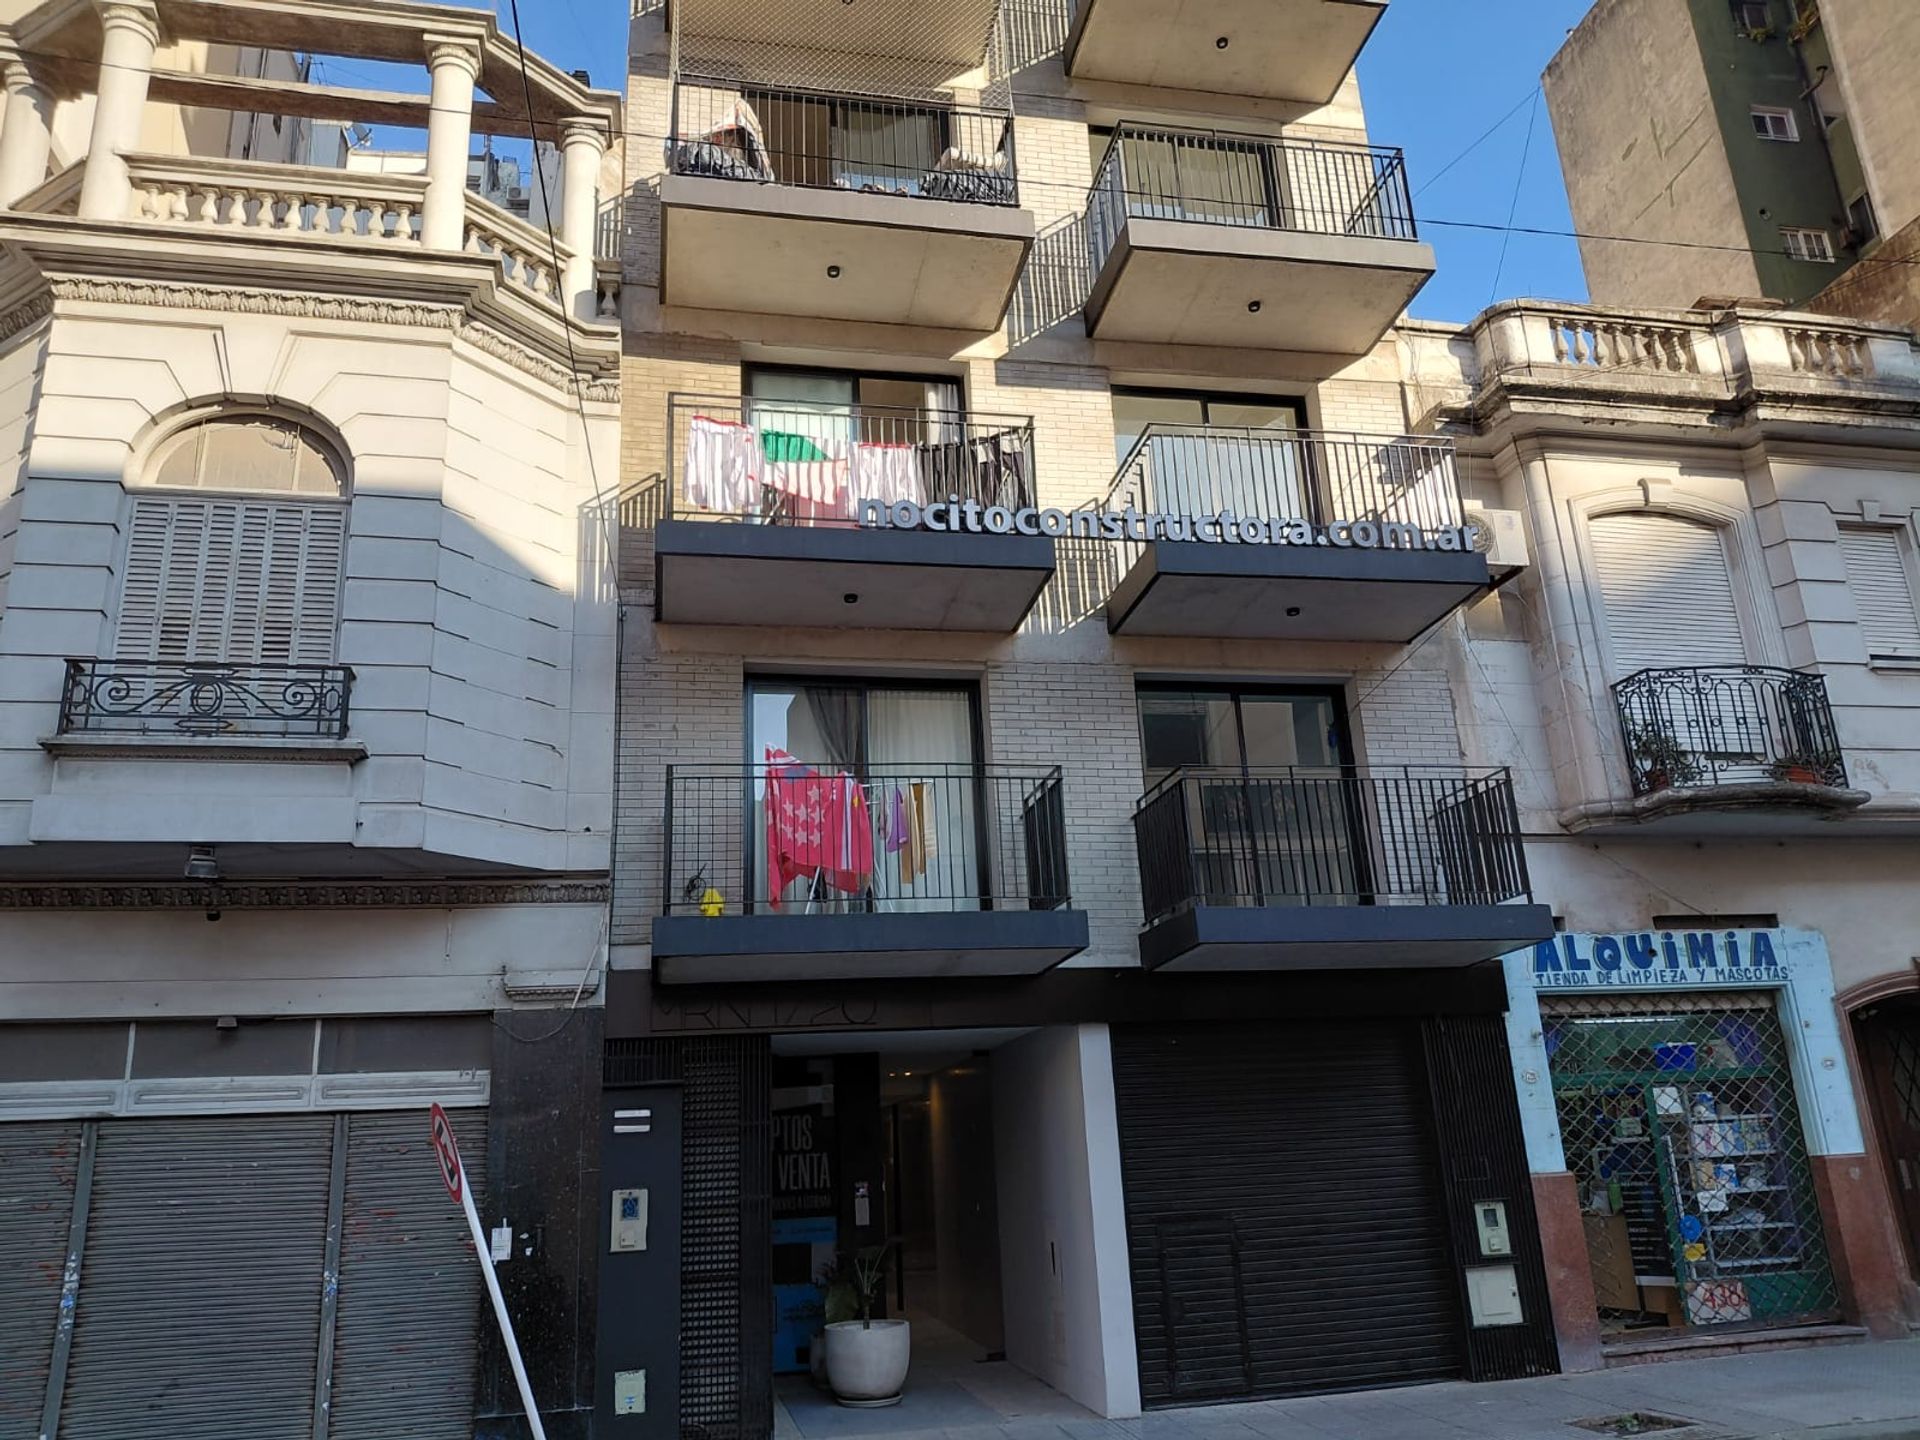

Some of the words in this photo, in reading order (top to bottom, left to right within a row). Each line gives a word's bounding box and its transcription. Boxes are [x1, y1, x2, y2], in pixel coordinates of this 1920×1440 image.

[858, 493, 1480, 552] nocitoconstructora.com.ar
[1535, 971, 1589, 985] TIENDA
[1597, 970, 1613, 984] DE
[1617, 967, 1688, 984] LIMPIEZA
[1696, 968, 1706, 982] Y
[1715, 966, 1789, 982] MASCOTAS
[778, 1151, 832, 1191] VENTA
